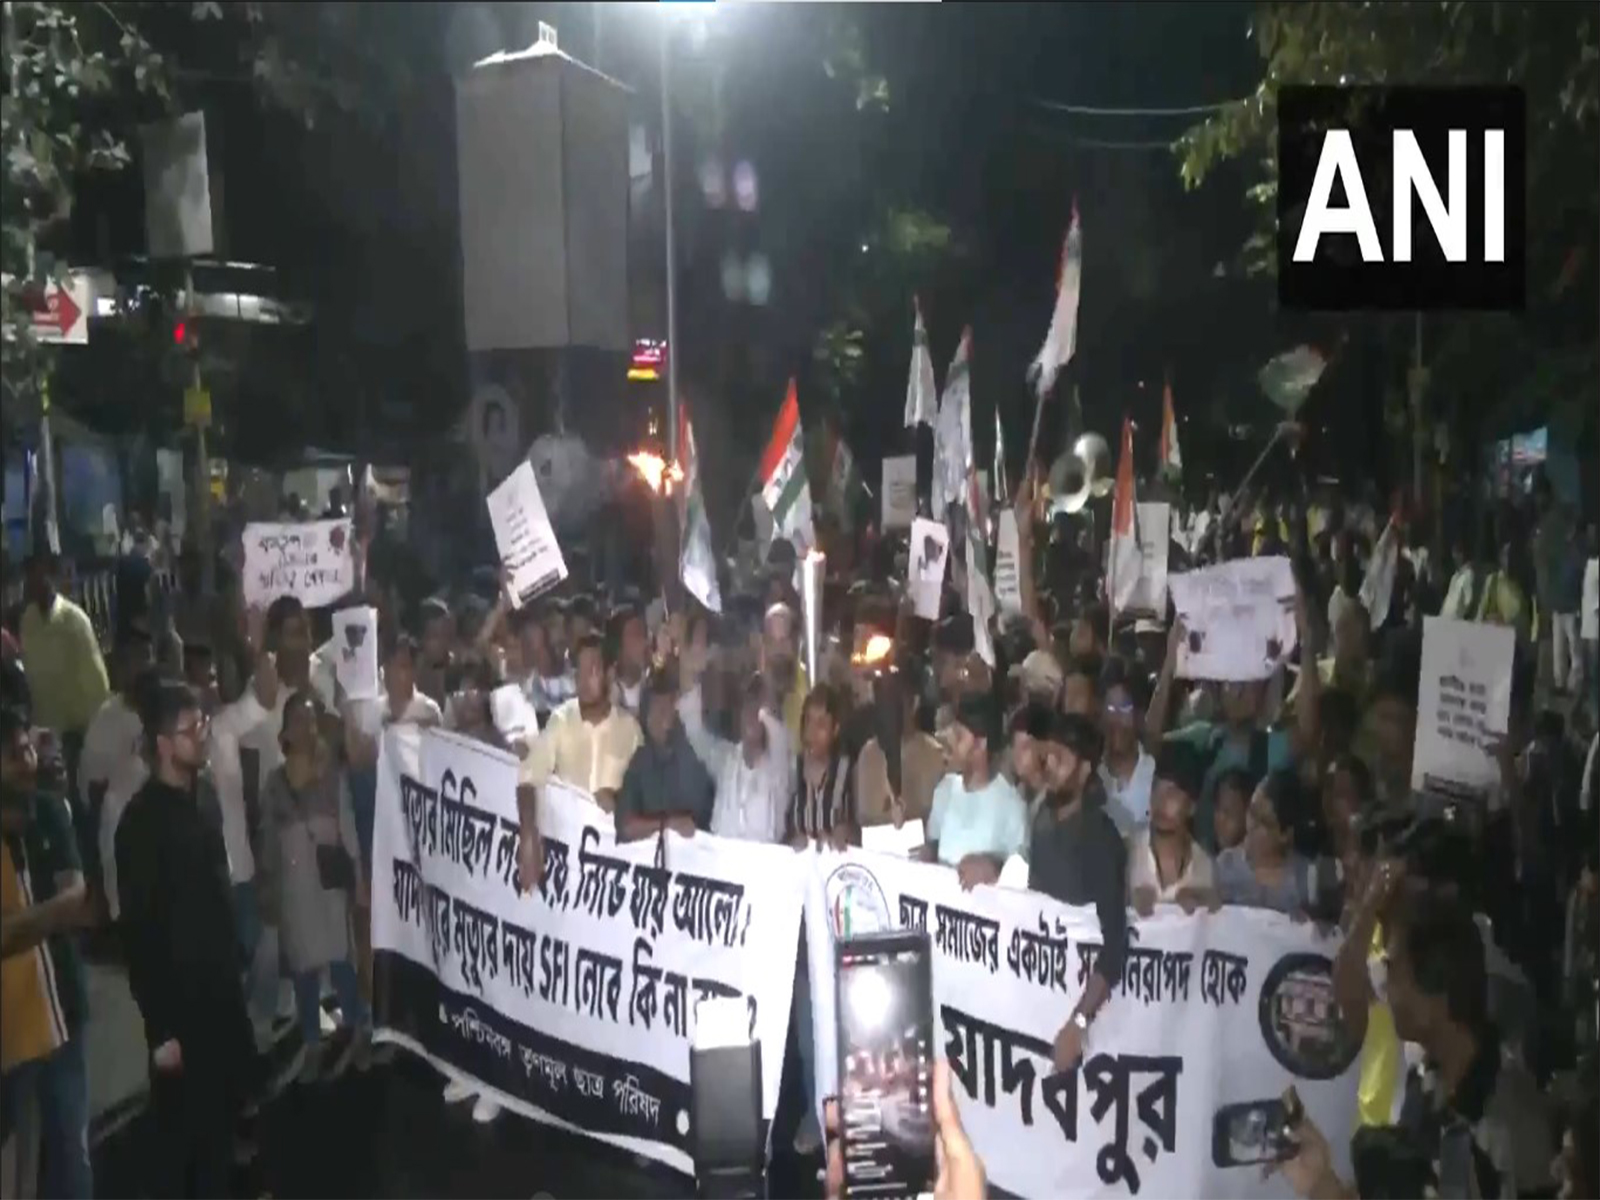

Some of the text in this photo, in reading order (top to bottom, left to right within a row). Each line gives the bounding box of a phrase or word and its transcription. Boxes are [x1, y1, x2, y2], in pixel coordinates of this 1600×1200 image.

[440, 767, 498, 878] মিছিল
[573, 825, 631, 918] নিভে
[630, 863, 672, 940] যায়
[501, 920, 537, 998] দায়
[540, 933, 570, 1006] SFI
[575, 947, 623, 1023] নেবে
[629, 936, 664, 1029] কি
[664, 971, 688, 1038] না
[935, 904, 1000, 975] সমাজের
[1006, 910, 1068, 994] একটাই
[1200, 949, 1249, 1008] হোক
[612, 1072, 662, 1127] পরিষদ
[940, 1003, 1184, 1196] যাদবপুর
